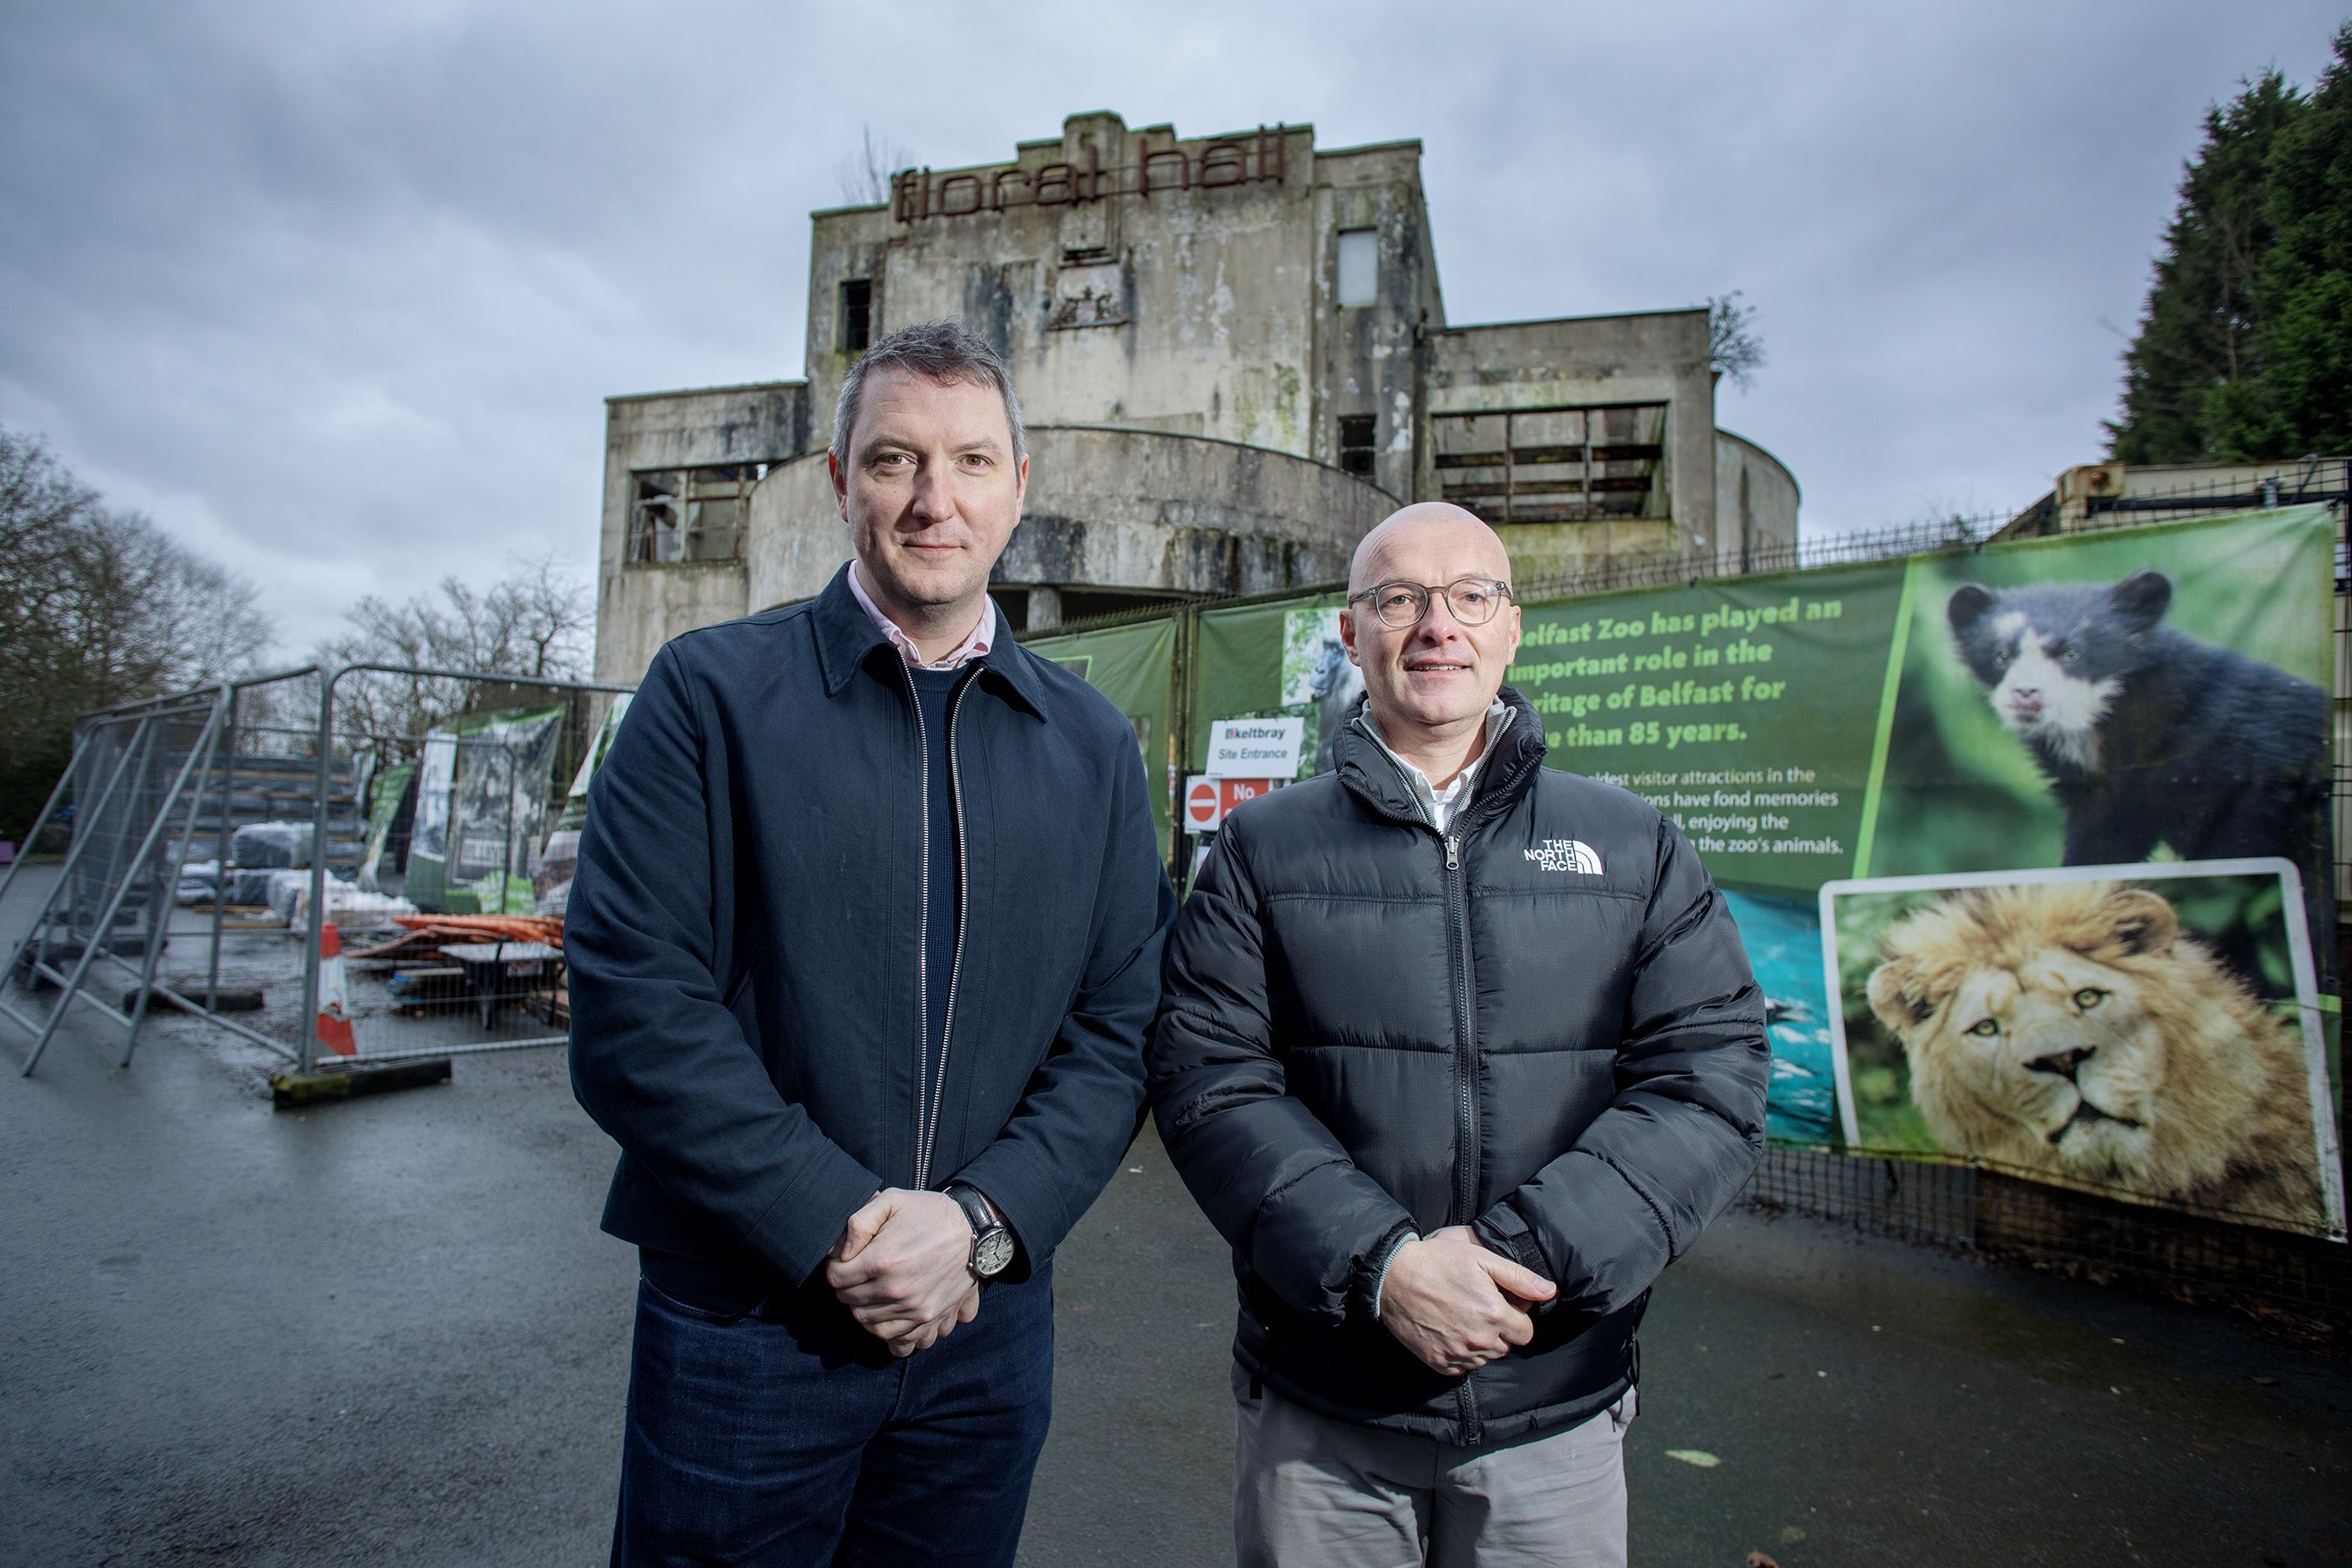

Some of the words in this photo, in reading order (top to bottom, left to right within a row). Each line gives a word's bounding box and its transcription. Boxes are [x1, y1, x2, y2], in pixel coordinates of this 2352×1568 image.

[893, 144, 1098, 223] floral
[1139, 122, 1284, 198] hall
[1519, 622, 1592, 647] elfast
[1597, 618, 1646, 640] Zoo
[1652, 611, 1695, 635] has
[1701, 597, 1800, 637] played
[1805, 599, 1842, 621] an
[1507, 652, 1629, 686] important
[1633, 645, 1687, 672] role
[1693, 643, 1719, 667] in
[1725, 638, 1774, 665] the
[1532, 692, 1601, 718] ritage
[1606, 684, 1636, 709] of
[1639, 679, 1734, 707] Belfast
[1740, 675, 1786, 701] for
[1234, 727, 1286, 740] keltbray
[1566, 723, 1623, 747] than
[1628, 721, 1660, 745] 85
[1666, 722, 1747, 750] years.
[1218, 748, 1238, 760] Site
[1240, 748, 1288, 760] Entrance
[1632, 771, 1678, 787] visitor
[1680, 768, 1764, 785] attractions
[1767, 767, 1783, 784] in
[1787, 766, 1816, 784] the
[1233, 783, 1255, 800] No
[1673, 791, 1711, 808] have
[1713, 789, 1751, 808] fond
[1754, 789, 1839, 808] memories
[1687, 813, 1758, 834] enjoying
[1761, 812, 1790, 830] the
[1542, 839, 1573, 850] THE
[1699, 835, 1726, 852] the
[1727, 836, 1770, 854] zoo's
[1772, 835, 1844, 855] animals.
[1523, 848, 1576, 862] NORTH
[1540, 861, 1578, 871] FACE
